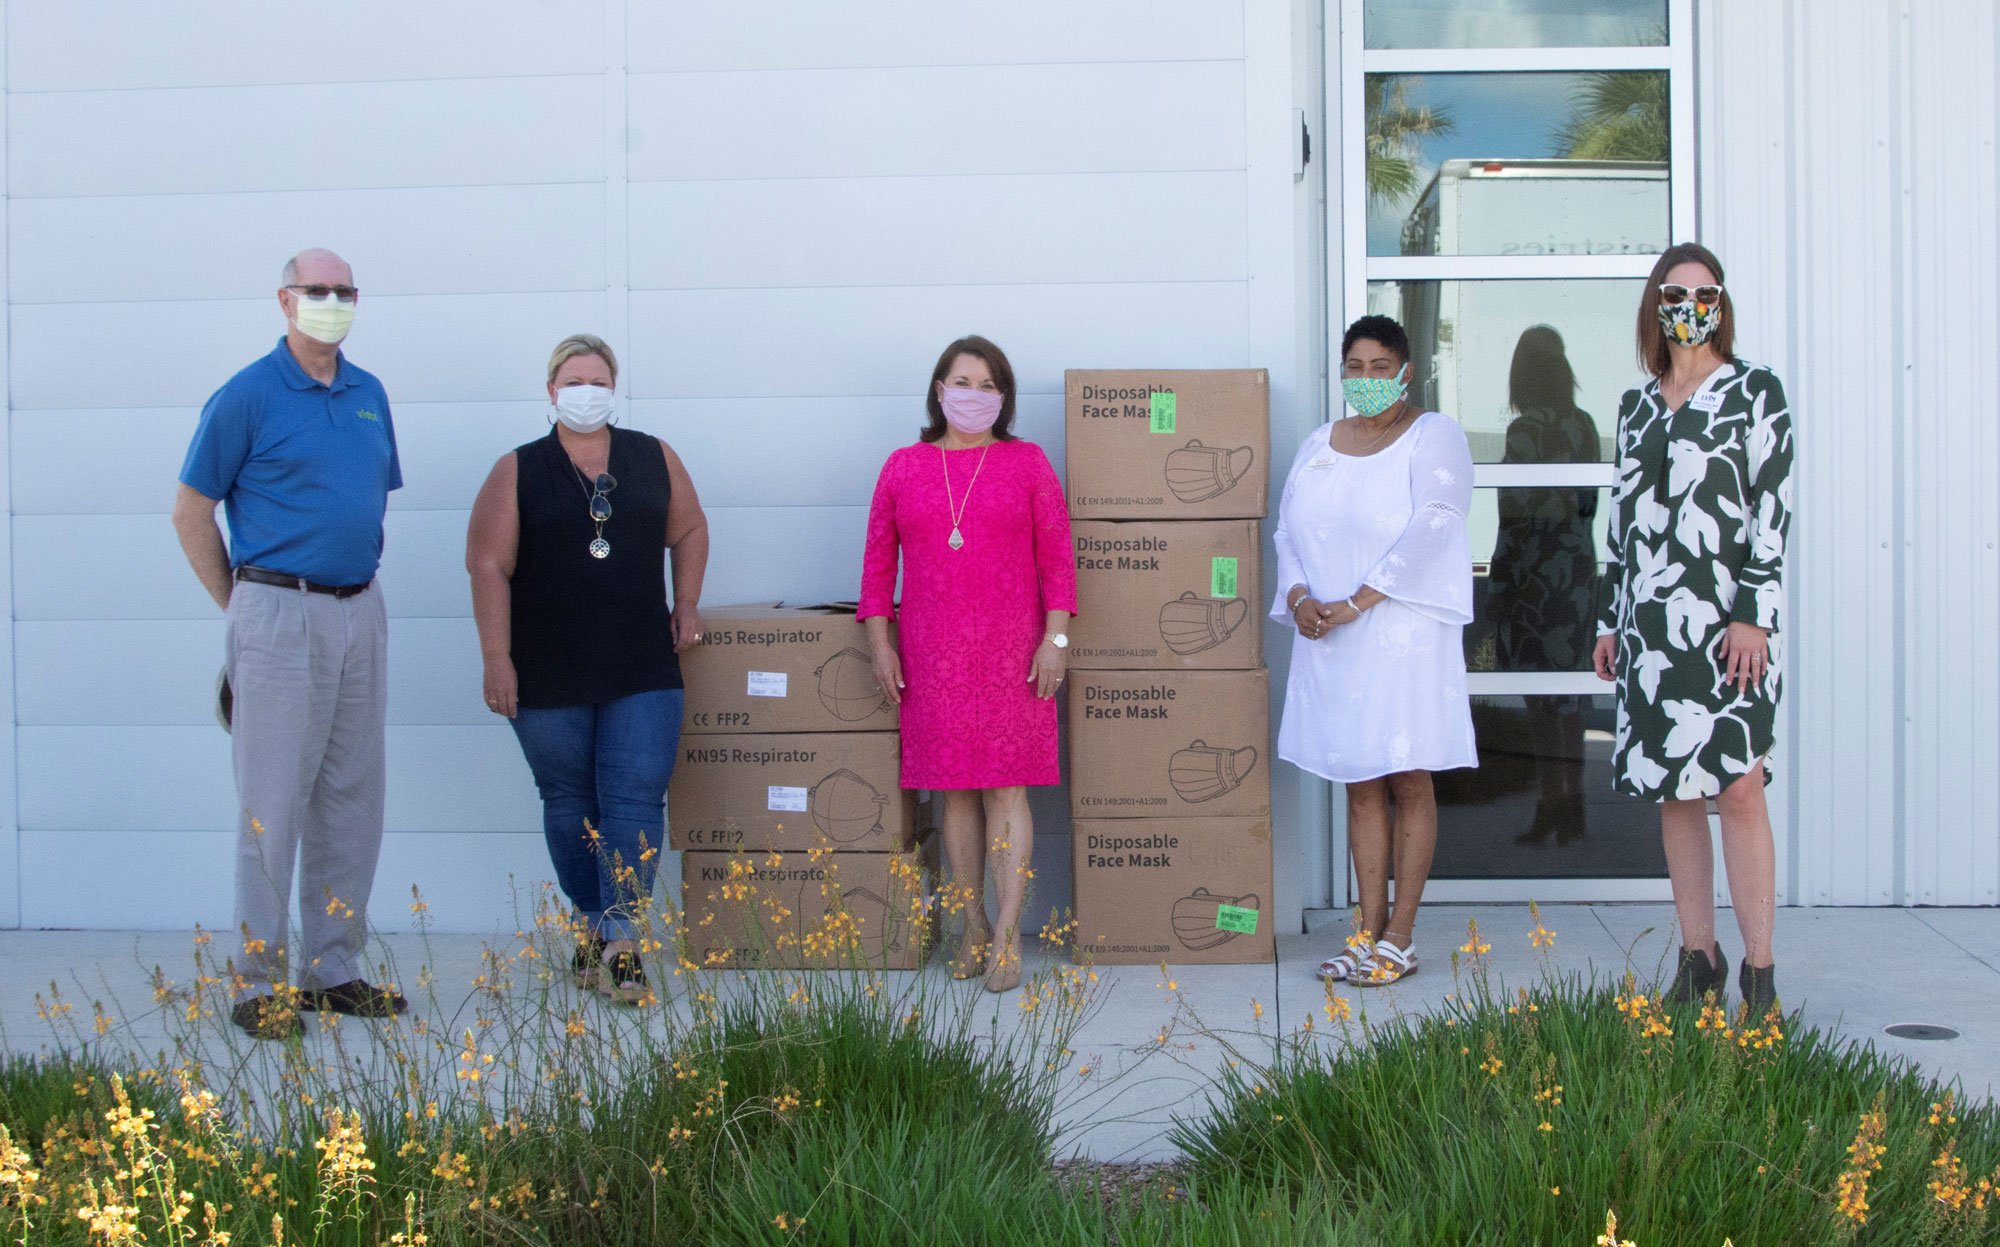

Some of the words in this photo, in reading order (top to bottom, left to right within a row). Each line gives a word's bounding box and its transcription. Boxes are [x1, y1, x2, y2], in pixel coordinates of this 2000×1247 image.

[1082, 404, 1118, 418] Face
[1123, 404, 1152, 418] Ma
[1077, 536, 1168, 554] Disposable
[1077, 556, 1113, 570] Face
[1118, 556, 1160, 570] Mask
[697, 631, 733, 646] N95
[737, 629, 823, 647] Respirator
[1085, 685, 1176, 703] Disposable
[717, 712, 750, 726] FFP2
[1085, 706, 1121, 719] Face
[1126, 705, 1169, 719] Mask
[686, 748, 728, 763] KN95
[733, 748, 817, 766] Respirator
[711, 830, 744, 844] FFP2
[1087, 834, 1179, 852] Disposable
[1087, 854, 1124, 867] Face
[1129, 853, 1171, 867] Mask
[748, 867, 826, 884] Respirato
[734, 948, 760, 961] FP2
